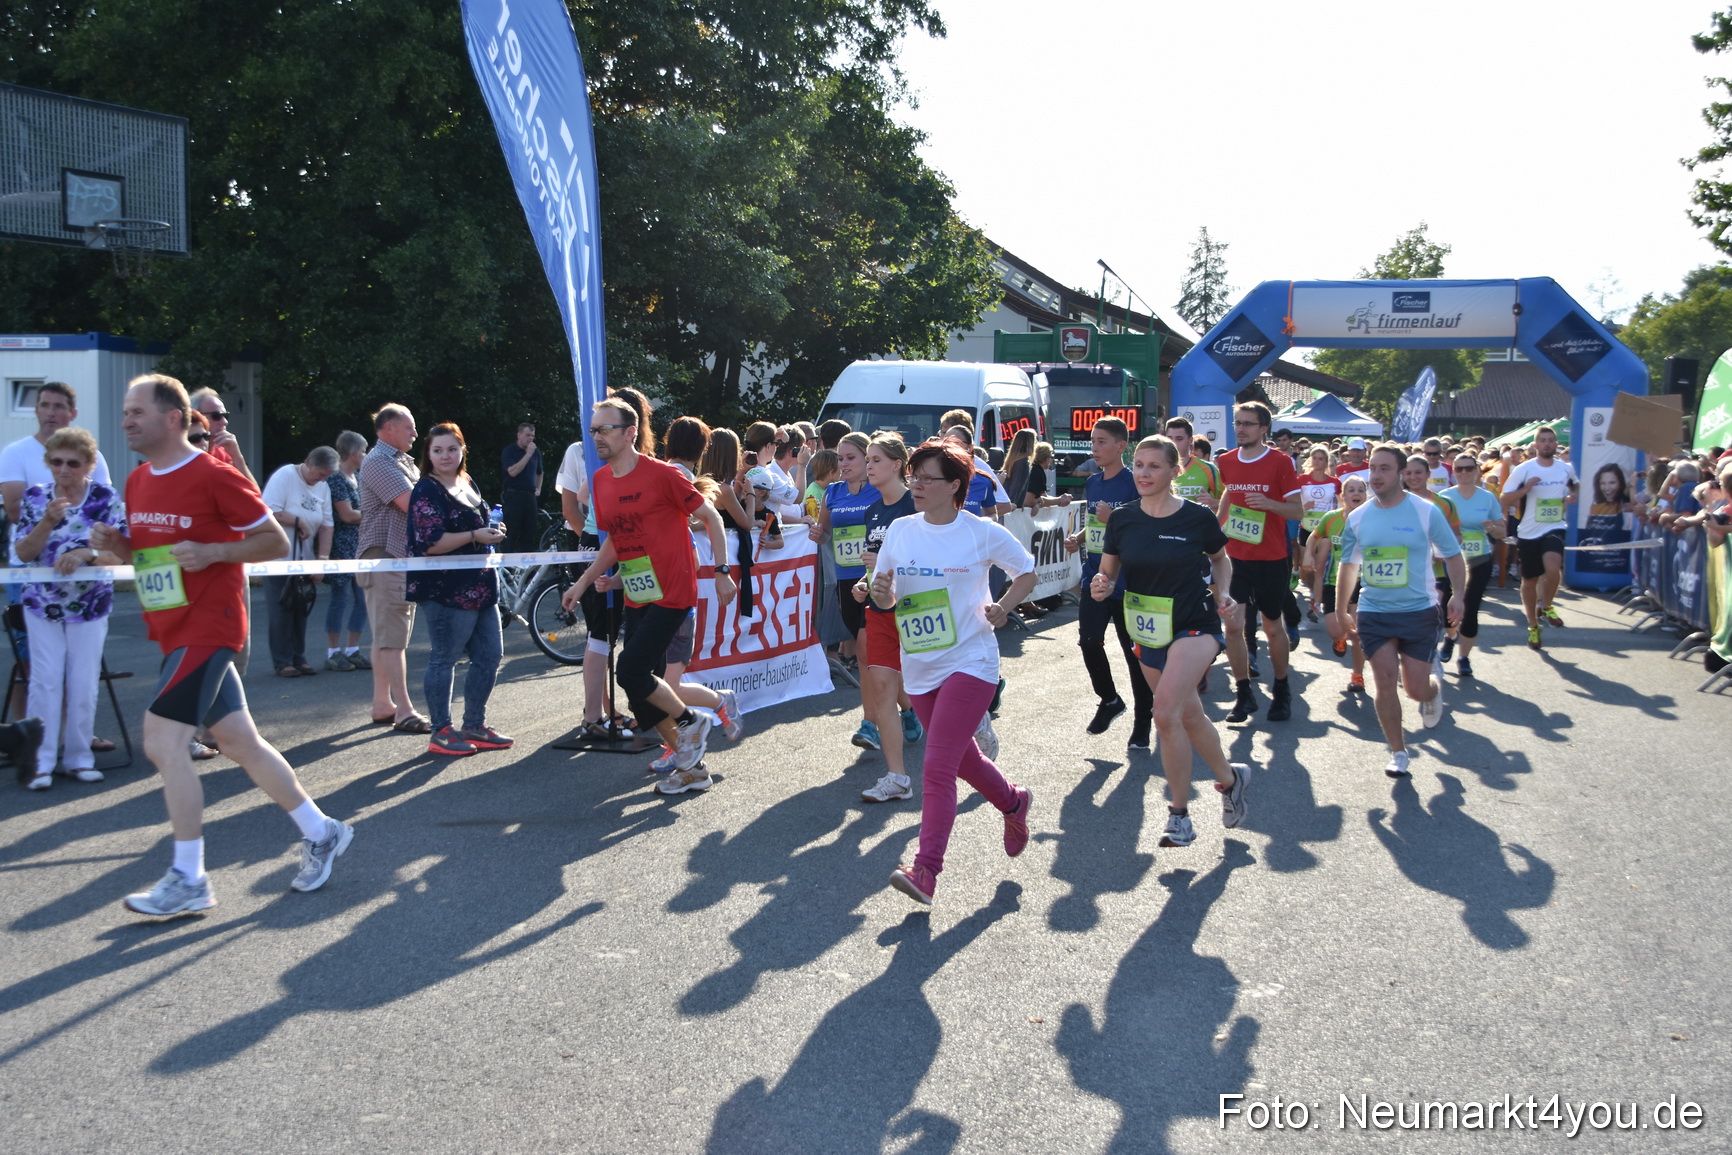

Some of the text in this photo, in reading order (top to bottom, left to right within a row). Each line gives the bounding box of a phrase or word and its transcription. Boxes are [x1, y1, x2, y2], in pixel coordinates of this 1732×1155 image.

[1378, 313, 1462, 328] firmenlauf
[1221, 342, 1265, 352] Fischer
[1227, 483, 1261, 492] EUMARKT
[1541, 508, 1558, 516] 285
[1230, 518, 1260, 535] 1418
[1366, 562, 1404, 577] 1427
[138, 570, 175, 595] 1401
[624, 574, 656, 593] 1535
[901, 612, 946, 638] 1301
[1135, 614, 1155, 634] 94
